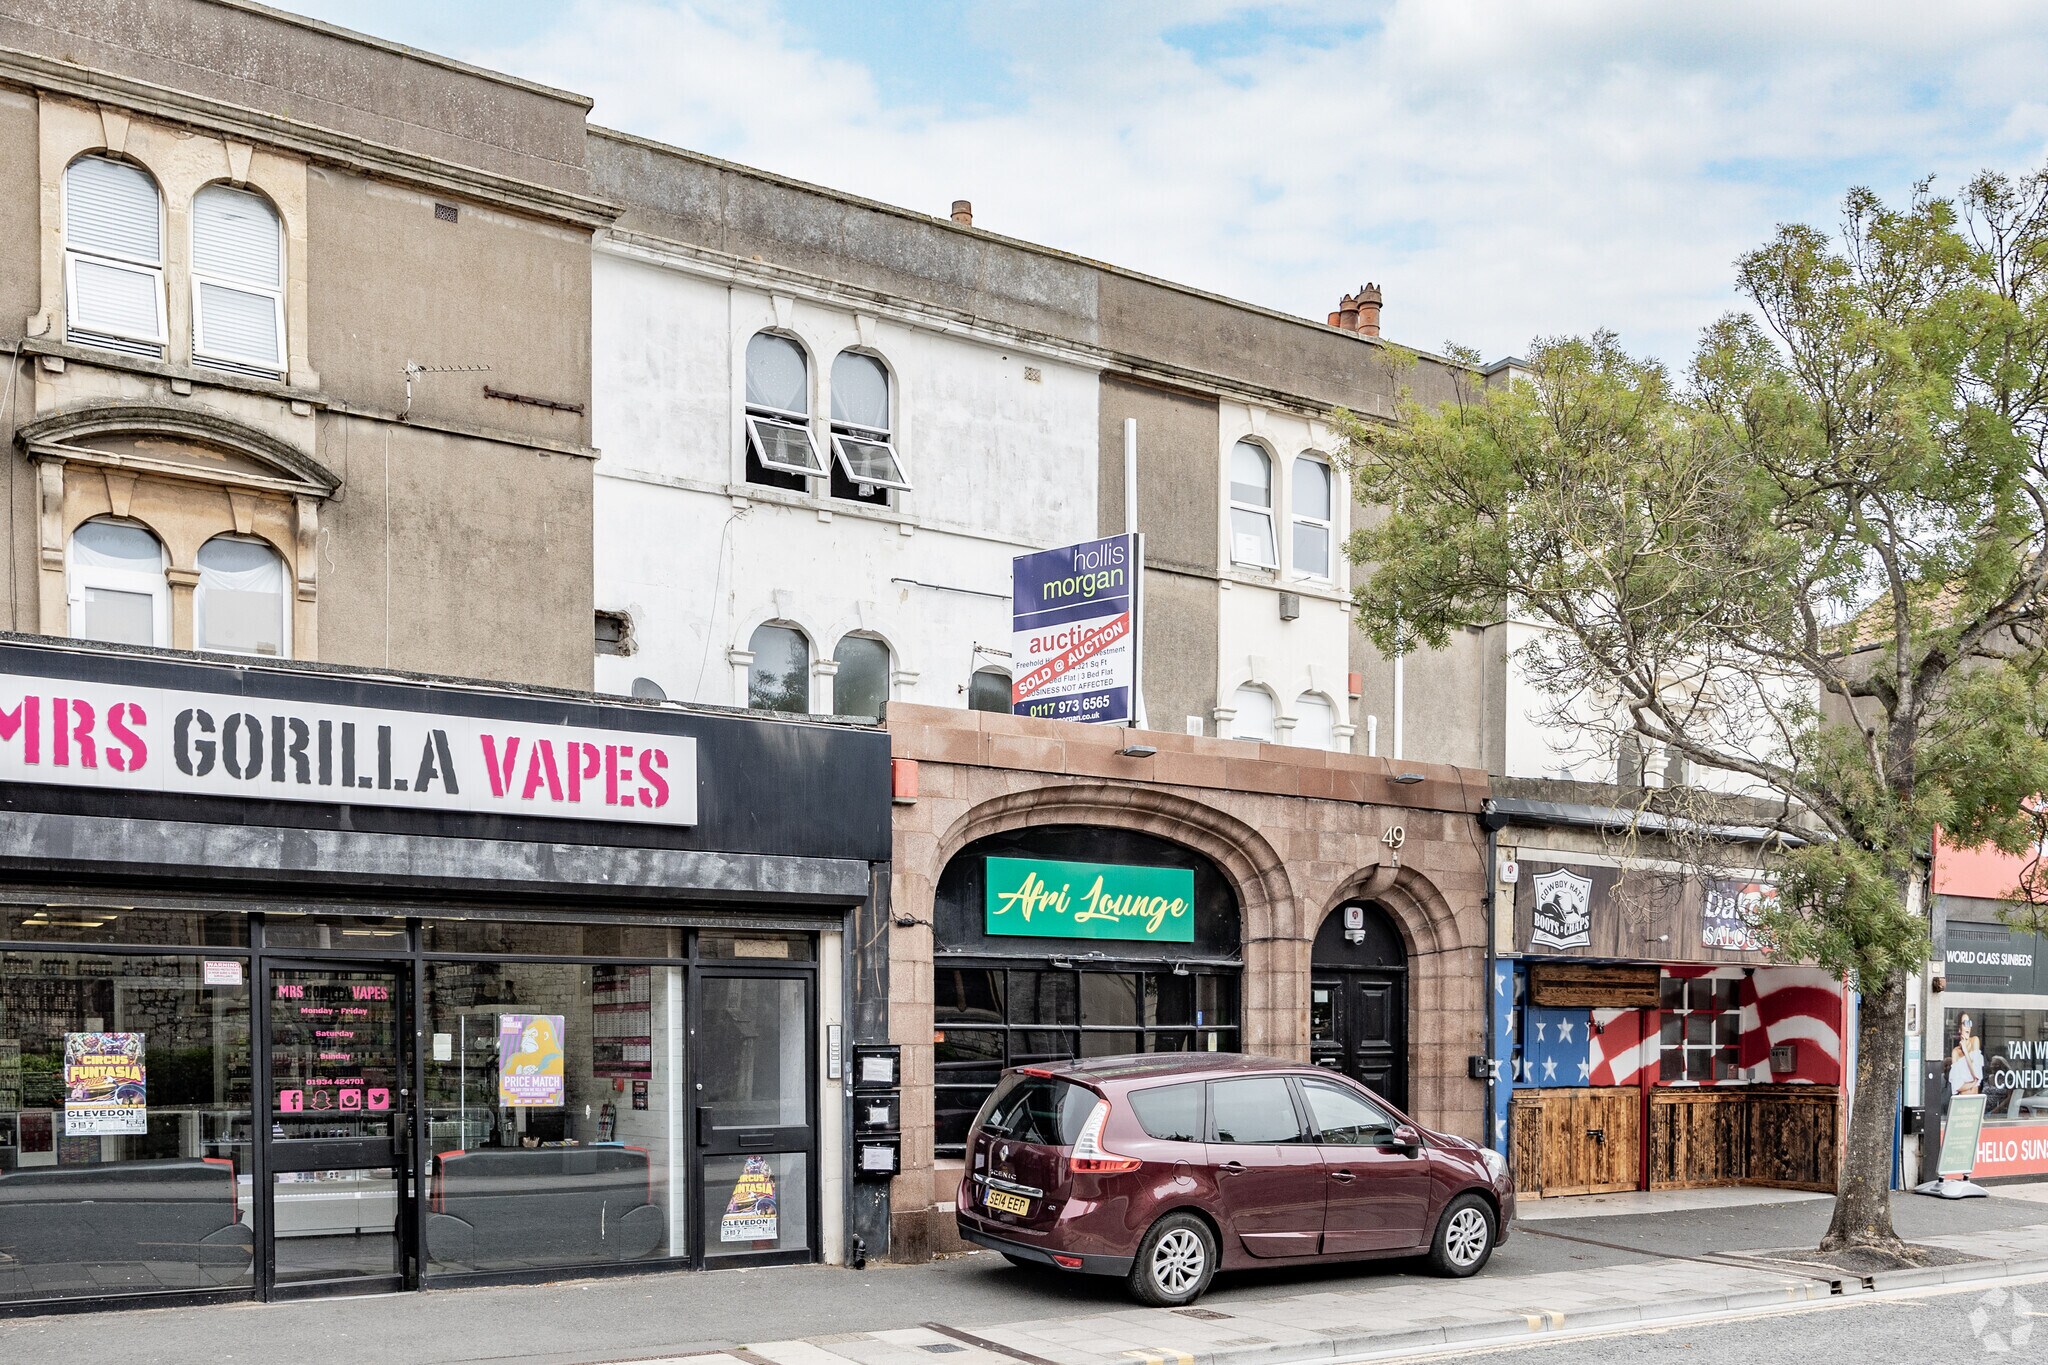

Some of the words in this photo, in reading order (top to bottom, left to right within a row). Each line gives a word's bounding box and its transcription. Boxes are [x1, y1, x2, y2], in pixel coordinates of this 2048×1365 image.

[1074, 543, 1125, 572] hollis
[1043, 568, 1124, 600] morgan
[1029, 625, 1101, 654] auctio
[1016, 658, 1043, 669] Freehold
[1018, 667, 1052, 695] SOLD
[1054, 659, 1065, 672] @
[1068, 621, 1124, 666] AUCTION
[1090, 660, 1099, 668] Sq
[1062, 684, 1076, 692] NOT
[1078, 678, 1113, 690] AFFECTED
[1063, 674, 1076, 682] Flat
[1087, 670, 1100, 678] Bed
[1030, 702, 1056, 717] 0117
[1058, 700, 1080, 713] 973
[1083, 695, 1110, 710] 6565
[173, 708, 460, 794] GORILLA
[480, 734, 670, 809] VAPES
[1381, 825, 1405, 849] 49
[1540, 880, 1569, 901] COWBOY
[1569, 883, 1585, 903] HATS
[993, 871, 1071, 922] Afri
[1074, 875, 1189, 933] Lounge
[1533, 911, 1560, 936] BOOTS
[1564, 915, 1590, 936] CHAPS
[1705, 926, 1773, 949] SALOO
[1946, 950, 1975, 964] WORLD
[1976, 951, 2000, 965] CLASS
[2001, 953, 2033, 967] SUNBEDS
[278, 985, 304, 998] MRS
[352, 985, 388, 1000] VAPES
[300, 1007, 333, 1015] Monday
[341, 1007, 368, 1015] Friday
[315, 1030, 354, 1038] Saturday
[320, 1053, 351, 1061] Sunday
[2008, 1040, 2032, 1060] TAN
[82, 1055, 129, 1065] CIRCUS
[70, 1065, 142, 1083] FUNTASIA
[504, 1076, 530, 1087] PRICE
[532, 1076, 560, 1087] MATCH
[1976, 1140, 2018, 1163] HELLO
[989, 1192, 1006, 1208] SE14
[722, 1219, 768, 1227] CLEVEDON
